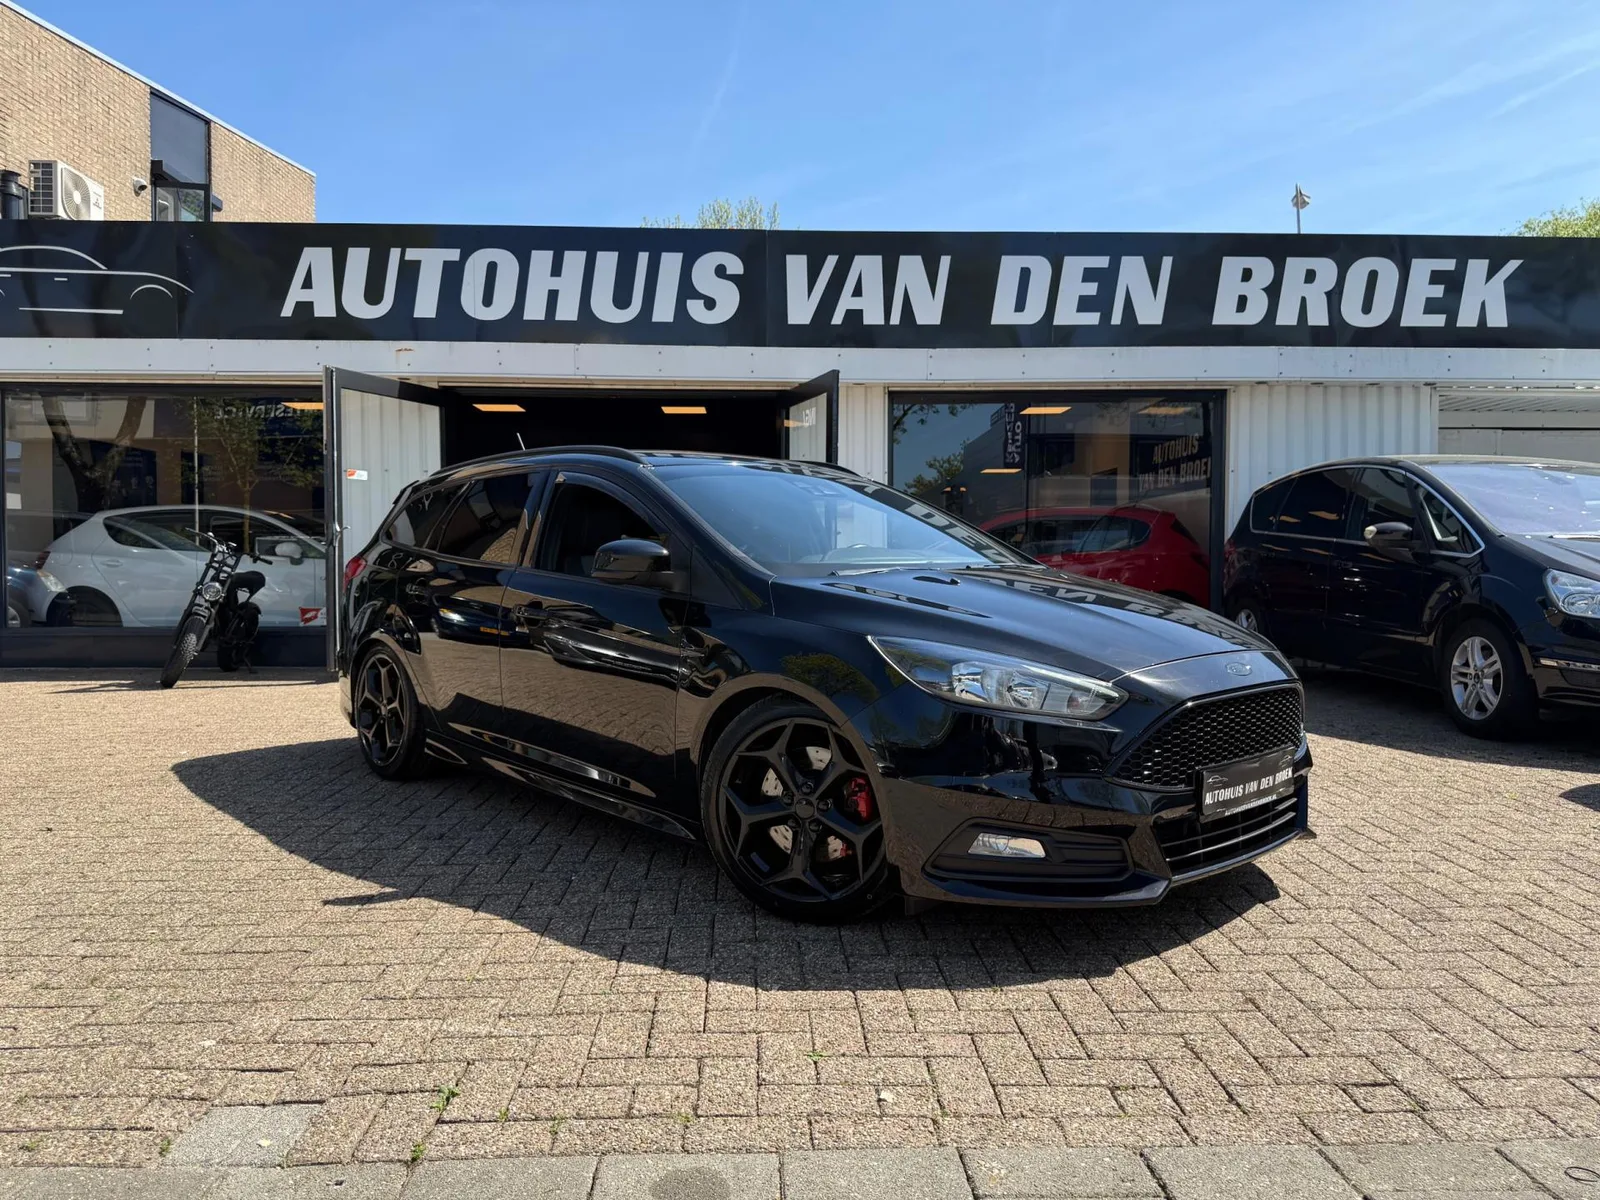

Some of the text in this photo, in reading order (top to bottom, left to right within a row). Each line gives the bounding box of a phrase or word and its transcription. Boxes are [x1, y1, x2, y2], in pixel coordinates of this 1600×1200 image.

[280, 246, 1525, 328] AUTOHUIS VAN DEN BROEK
[1152, 433, 1200, 464] AUTOHUIS
[1139, 471, 1155, 492] VAN
[1158, 465, 1177, 488] DEN
[1205, 767, 1294, 805] AUTOHUIS VAN DEN BROEK
